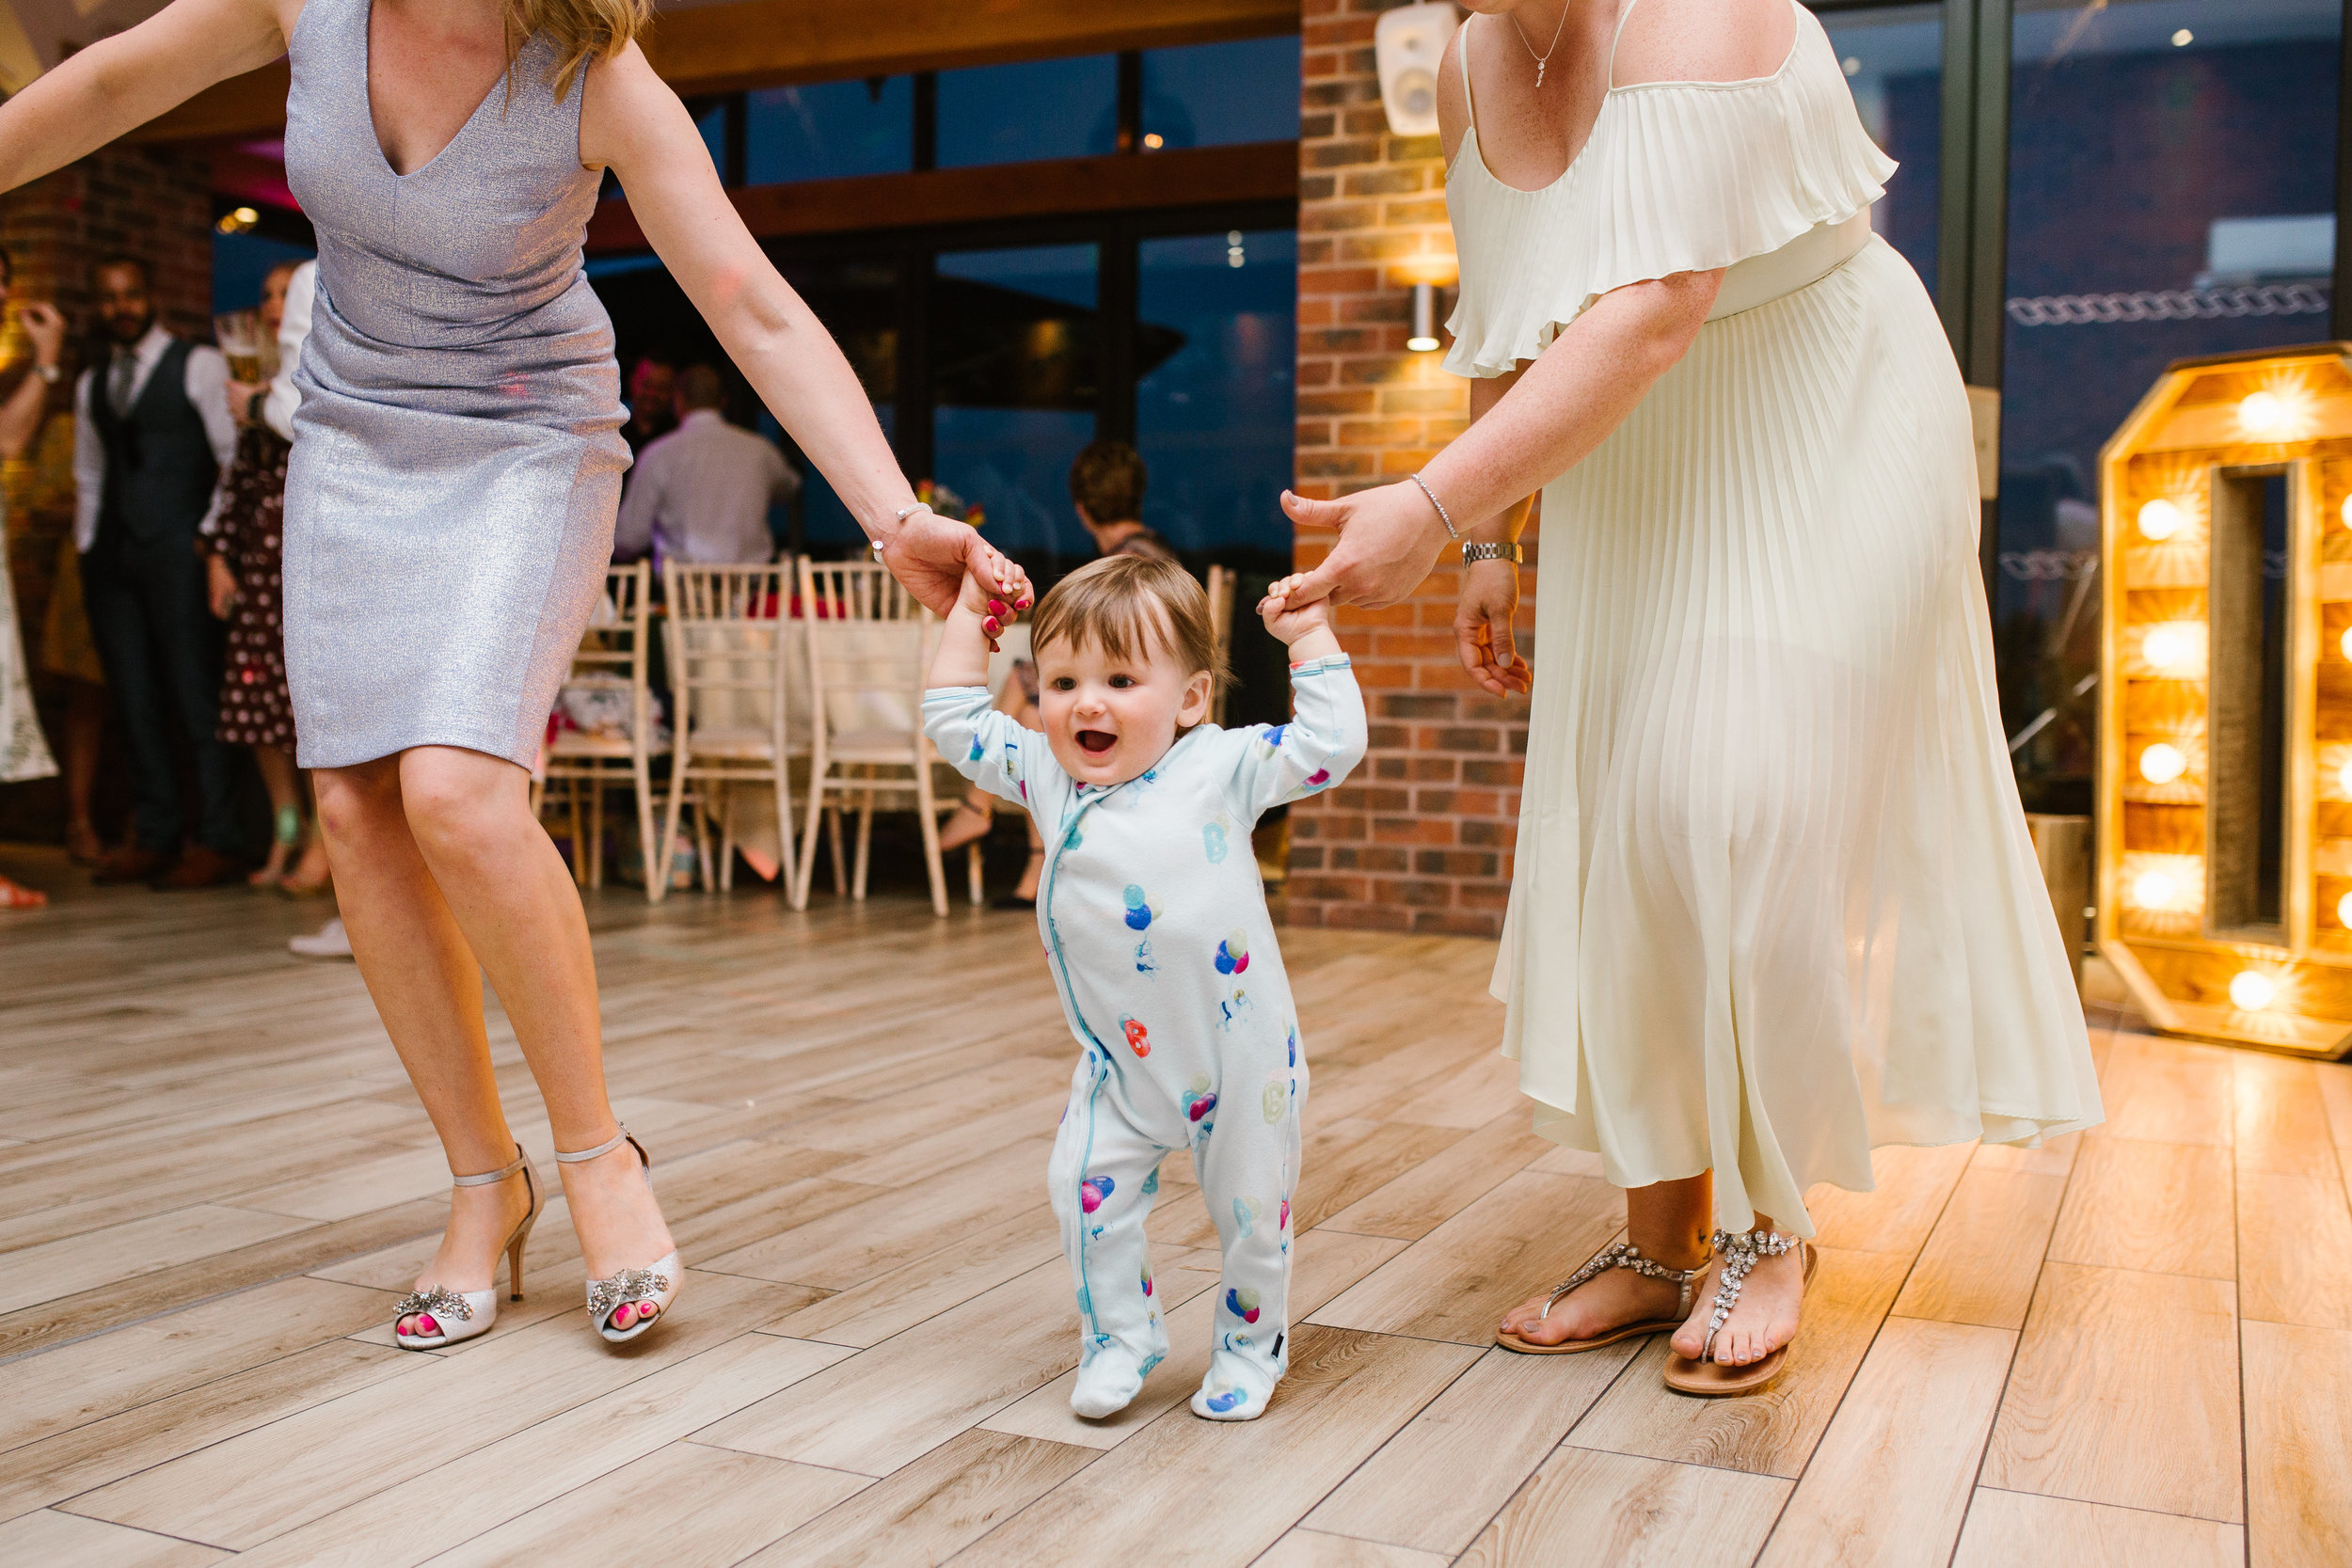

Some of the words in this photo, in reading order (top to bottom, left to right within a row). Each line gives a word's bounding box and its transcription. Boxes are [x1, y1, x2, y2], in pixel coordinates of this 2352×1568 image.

[1202, 821, 1229, 864] B
[1123, 1019, 1151, 1059] B
[1262, 1081, 1286, 1125] B
